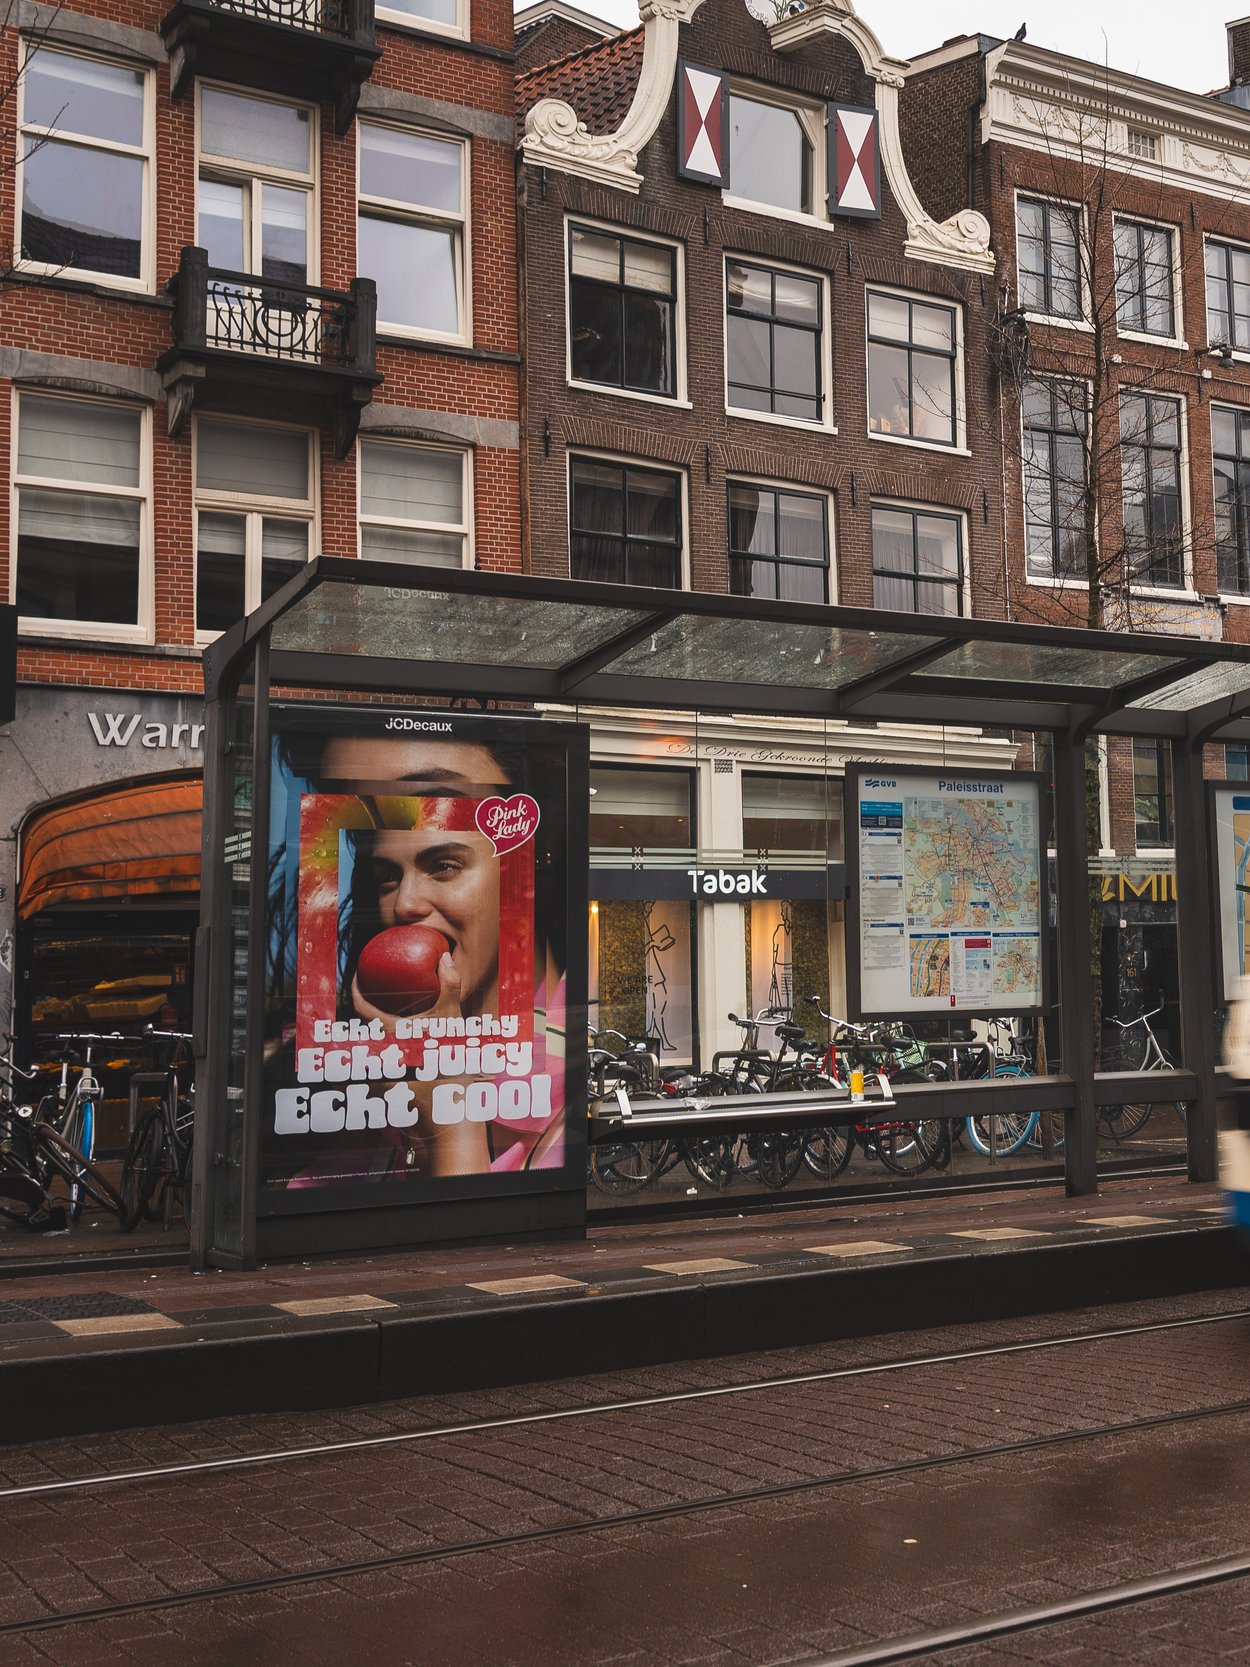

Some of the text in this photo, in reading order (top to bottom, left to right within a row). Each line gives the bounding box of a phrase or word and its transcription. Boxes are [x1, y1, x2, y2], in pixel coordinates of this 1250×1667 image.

[385, 717, 453, 732] JCDecaux
[703, 745, 747, 757] Drie
[880, 778, 897, 788] GVB
[938, 780, 1004, 794] Paleisstraat
[486, 799, 528, 828] Pink
[492, 816, 531, 840] Lady
[687, 869, 768, 894] Tabak
[313, 1013, 519, 1043] Echt crunchy
[297, 1037, 533, 1083] Echt juicy
[274, 1074, 552, 1135] Echt cool
